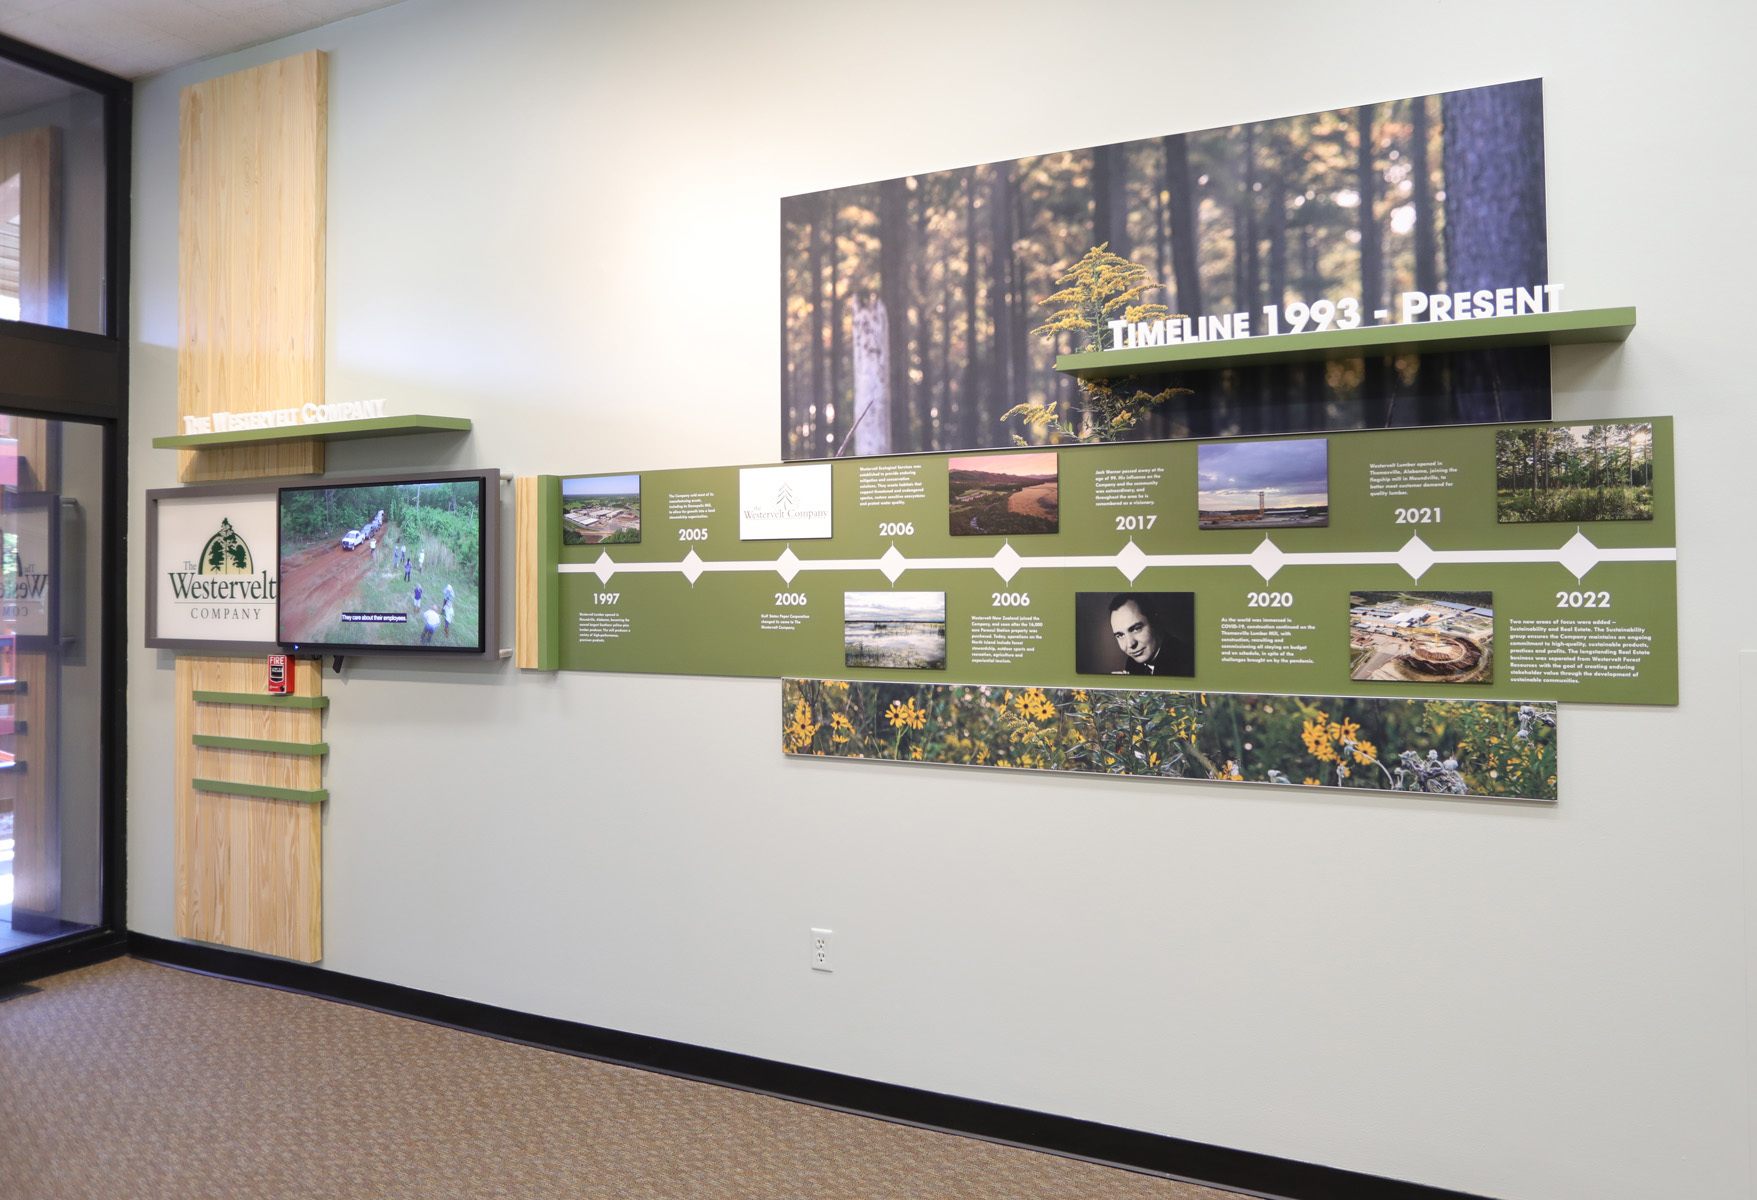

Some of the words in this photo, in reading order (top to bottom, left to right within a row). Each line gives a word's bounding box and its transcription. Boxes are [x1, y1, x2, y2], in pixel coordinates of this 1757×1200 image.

[1108, 312, 1250, 350] TIMELINE
[1263, 297, 1361, 336] 1993
[1374, 309, 1388, 320] -
[1402, 284, 1565, 324] PRESENT
[184, 415, 210, 435] THE
[302, 399, 387, 424] COMPANY
[743, 509, 785, 519] Westervelt
[787, 509, 829, 520] Company
[1395, 508, 1441, 524] 2021
[879, 522, 914, 537] 2006
[1115, 516, 1157, 531] 2017
[678, 528, 708, 541] 2005
[183, 561, 197, 571] The
[168, 570, 278, 599] Westervelt
[593, 593, 620, 605] 1997
[775, 593, 807, 606] 2006
[991, 592, 1031, 607] 2006
[1247, 592, 1293, 608] 2020
[1556, 592, 1611, 608] 2022
[190, 607, 262, 620] COMPANY
[270, 656, 285, 665] FIRE
[1548, 655, 1576, 663] separated
[1584, 663, 1608, 671] creating
